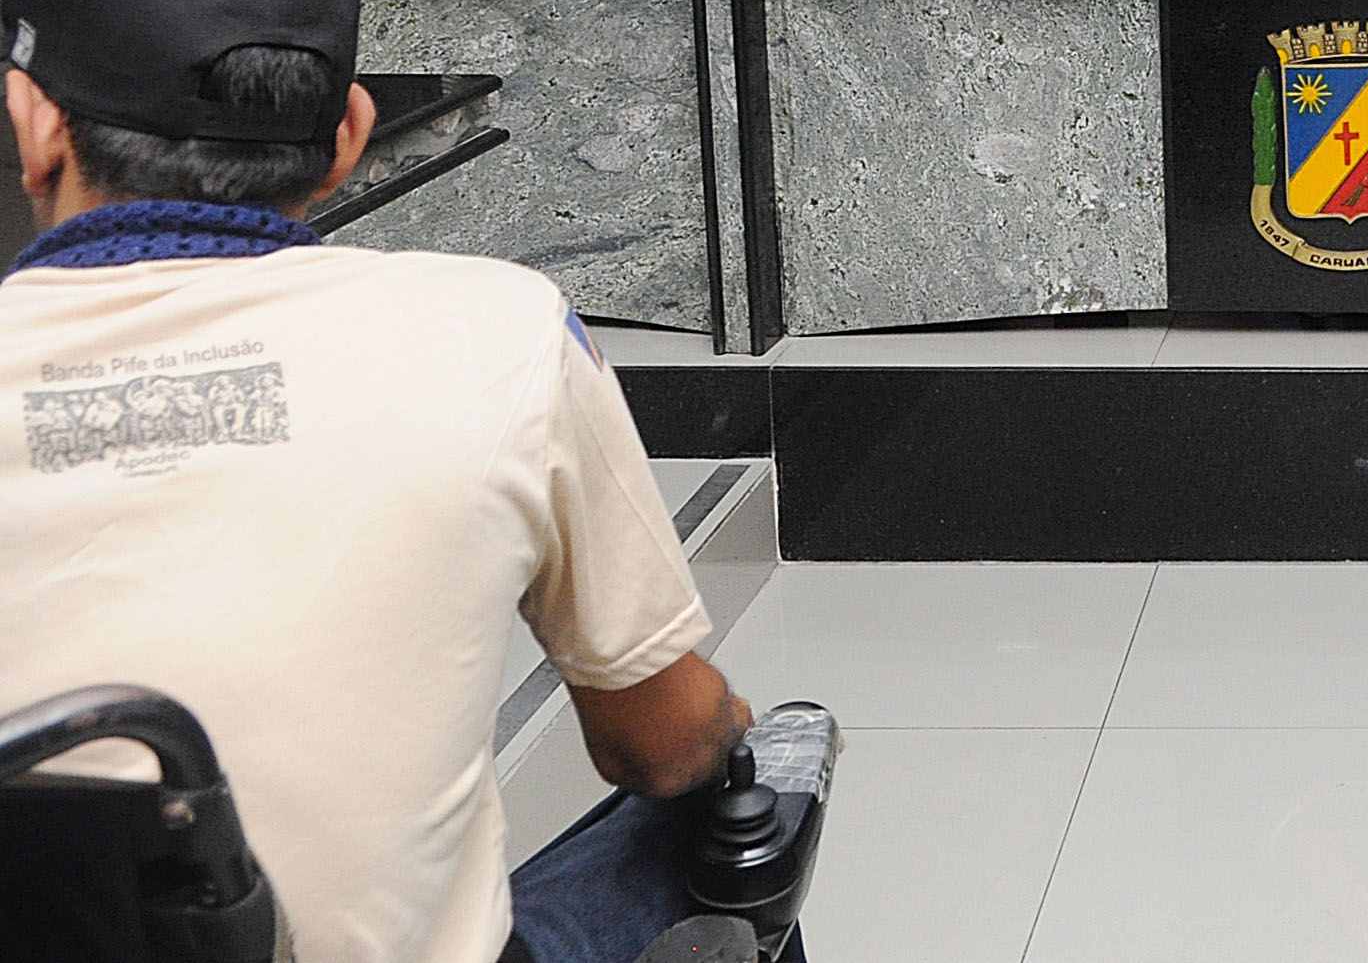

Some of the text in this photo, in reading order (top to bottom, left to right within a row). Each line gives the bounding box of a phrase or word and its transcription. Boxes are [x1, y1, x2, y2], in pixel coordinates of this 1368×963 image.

[1259, 220, 1290, 247] 1847
[41, 339, 265, 384] Banda Pife da Inclusão
